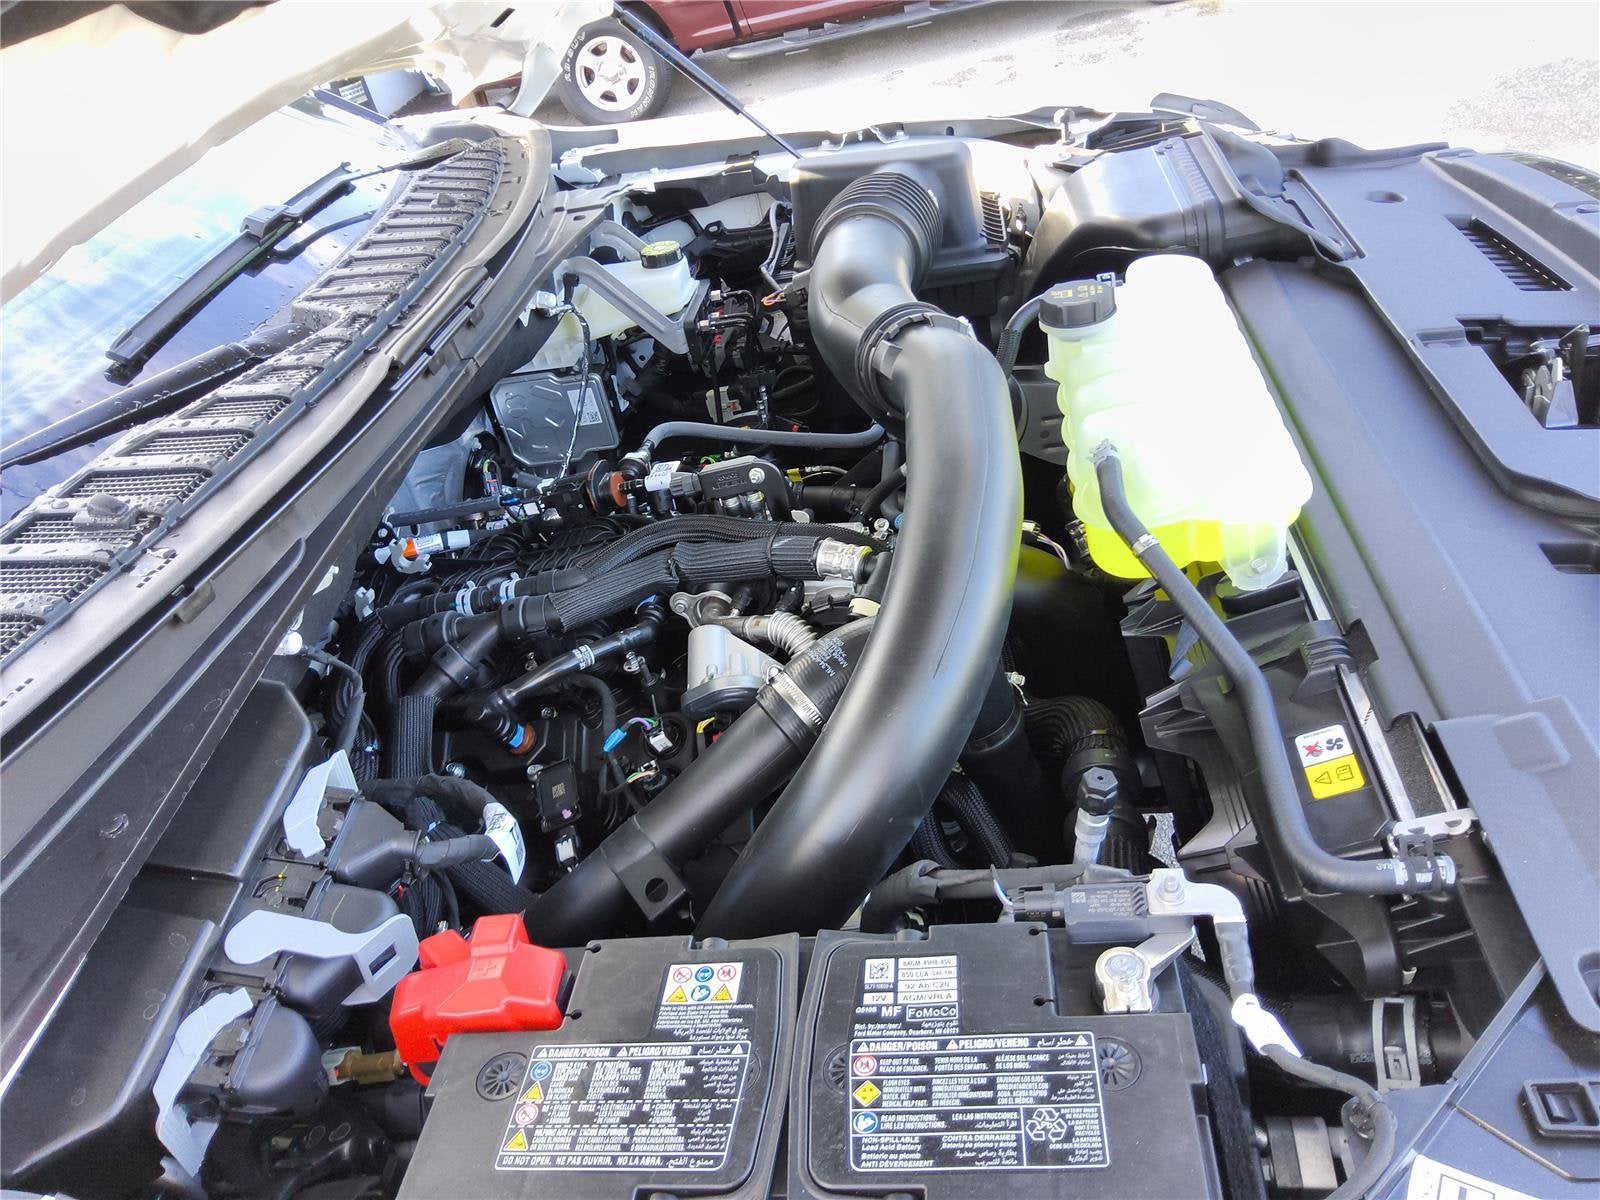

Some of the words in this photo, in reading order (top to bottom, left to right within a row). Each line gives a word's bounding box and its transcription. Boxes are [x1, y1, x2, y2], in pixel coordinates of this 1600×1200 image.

[881, 1006, 903, 1017] MF
[908, 1006, 956, 1018] FoMoCo
[883, 1029, 908, 1037] Company,
[869, 1041, 938, 1052] DANGER/POISON
[958, 1038, 1029, 1049] PELIGRO/VENENO
[548, 1048, 611, 1058] DANGER/POISON
[628, 1046, 692, 1057] PELIGRO/VENENO
[880, 1114, 896, 1122] READ
[896, 1114, 939, 1122] INSTRUCTIONS.
[952, 1112, 961, 1121] LEA
[961, 1112, 974, 1121] LAS
[974, 1112, 1020, 1121] INSTRUCCIONES.
[880, 1121, 893, 1129] LIRE
[893, 1121, 904, 1129] LES
[904, 1121, 947, 1129] INSTRUCTIONS.
[1040, 1121, 1053, 1129] Pb
[861, 1143, 878, 1152] Lead
[879, 1143, 895, 1152] Acid
[896, 1143, 922, 1152] Battery
[502, 1156, 514, 1165] DO
[514, 1156, 530, 1165] NOT
[530, 1156, 552, 1165] OPEN.
[555, 1156, 566, 1166] NE
[566, 1156, 581, 1166] PAS
[582, 1156, 613, 1166] OUVRIR.
[616, 1156, 628, 1166] NO
[628, 1156, 639, 1166] LA
[639, 1156, 663, 1166] ABRA.
[861, 1152, 888, 1161] Batterie
[888, 1152, 898, 1161] au
[898, 1152, 922, 1161] plomb
[861, 1159, 878, 1168] ANTI
[879, 1159, 934, 1168] DÉVERSEMENT
